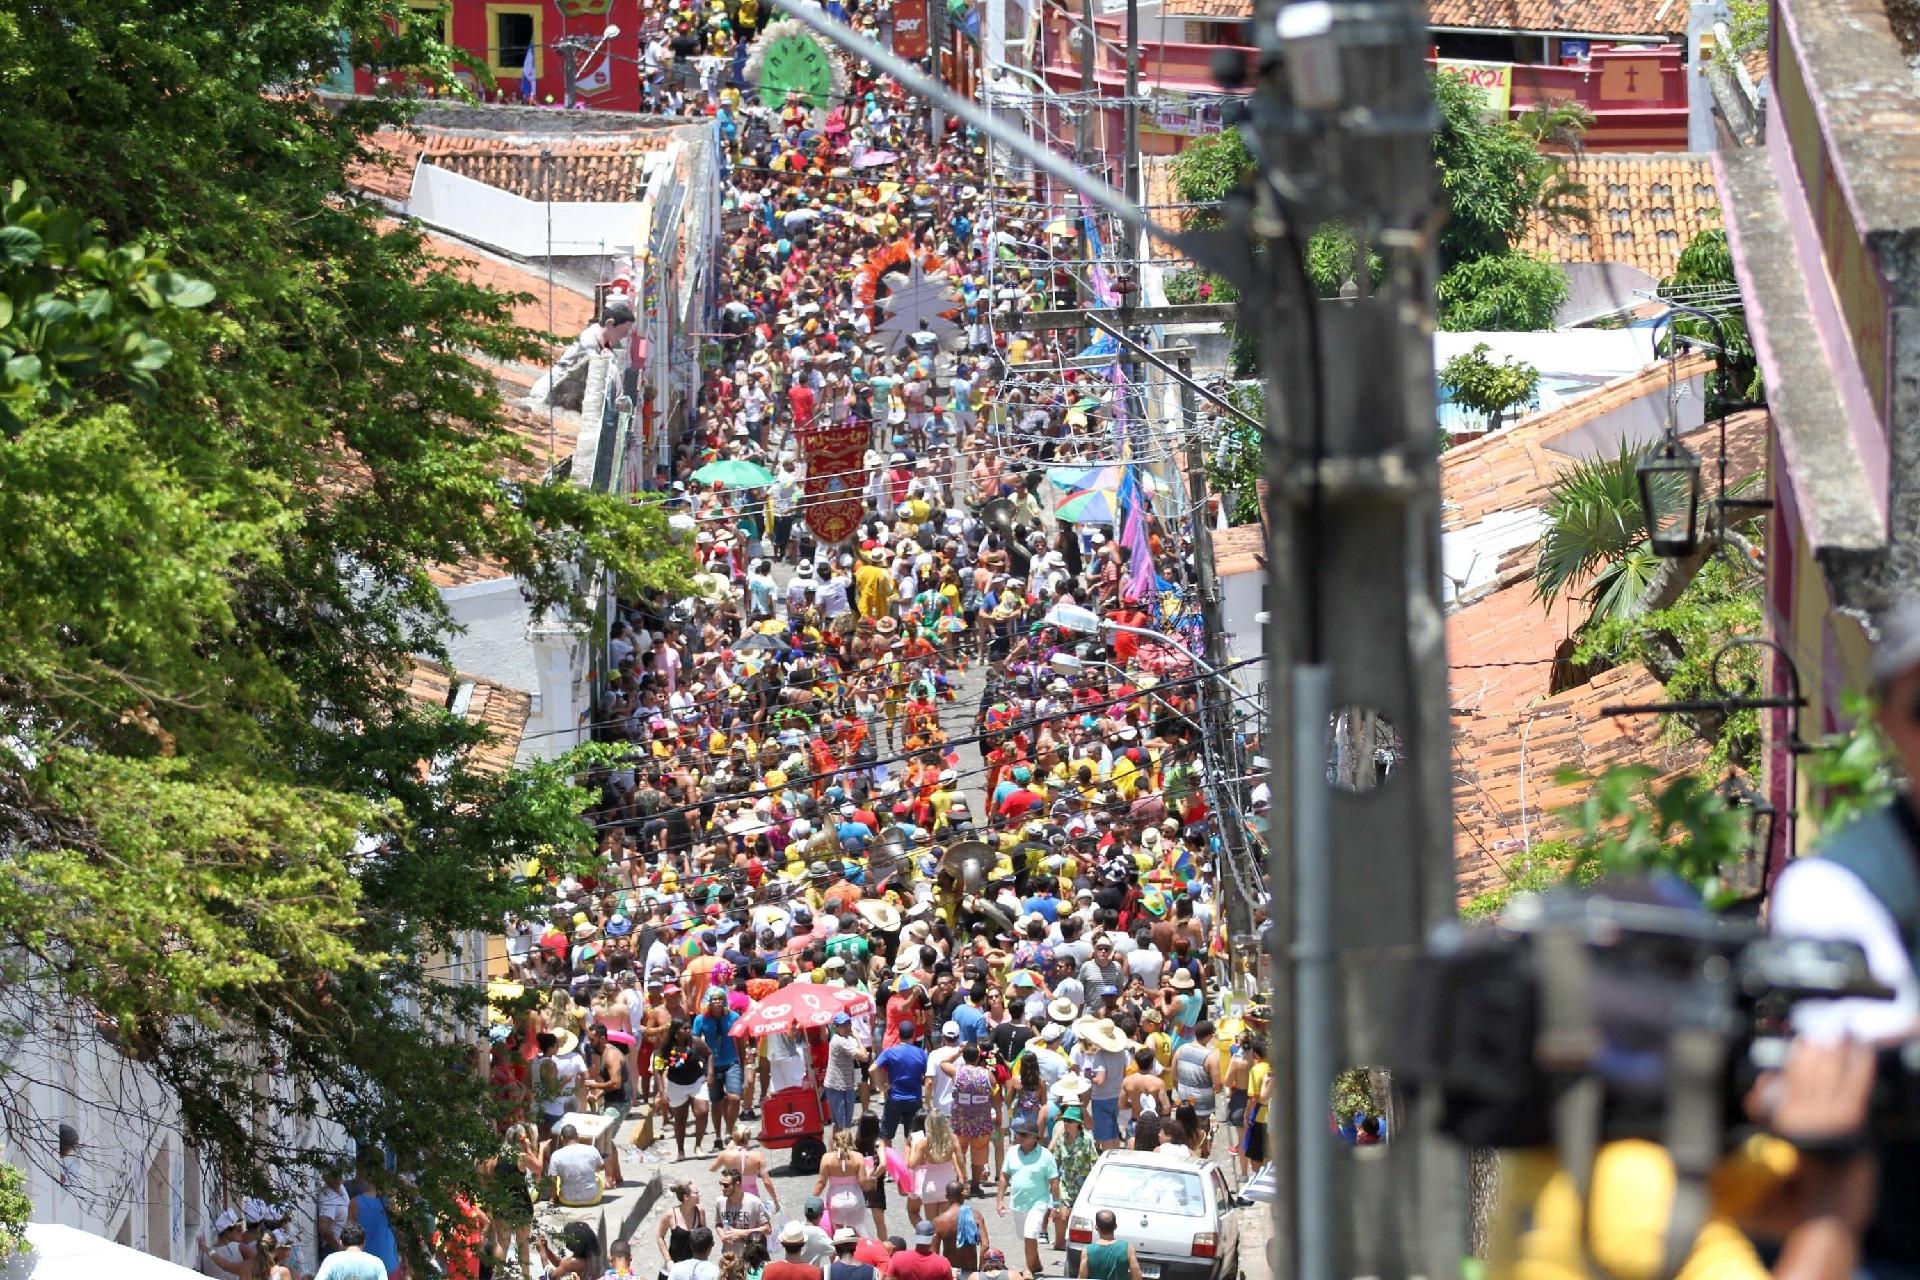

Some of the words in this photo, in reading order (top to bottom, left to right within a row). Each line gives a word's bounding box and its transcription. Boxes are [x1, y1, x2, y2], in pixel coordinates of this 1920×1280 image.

[895, 19, 921, 31] SKY
[1459, 68, 1505, 87] SKOL
[721, 1211, 750, 1222] NEVER
